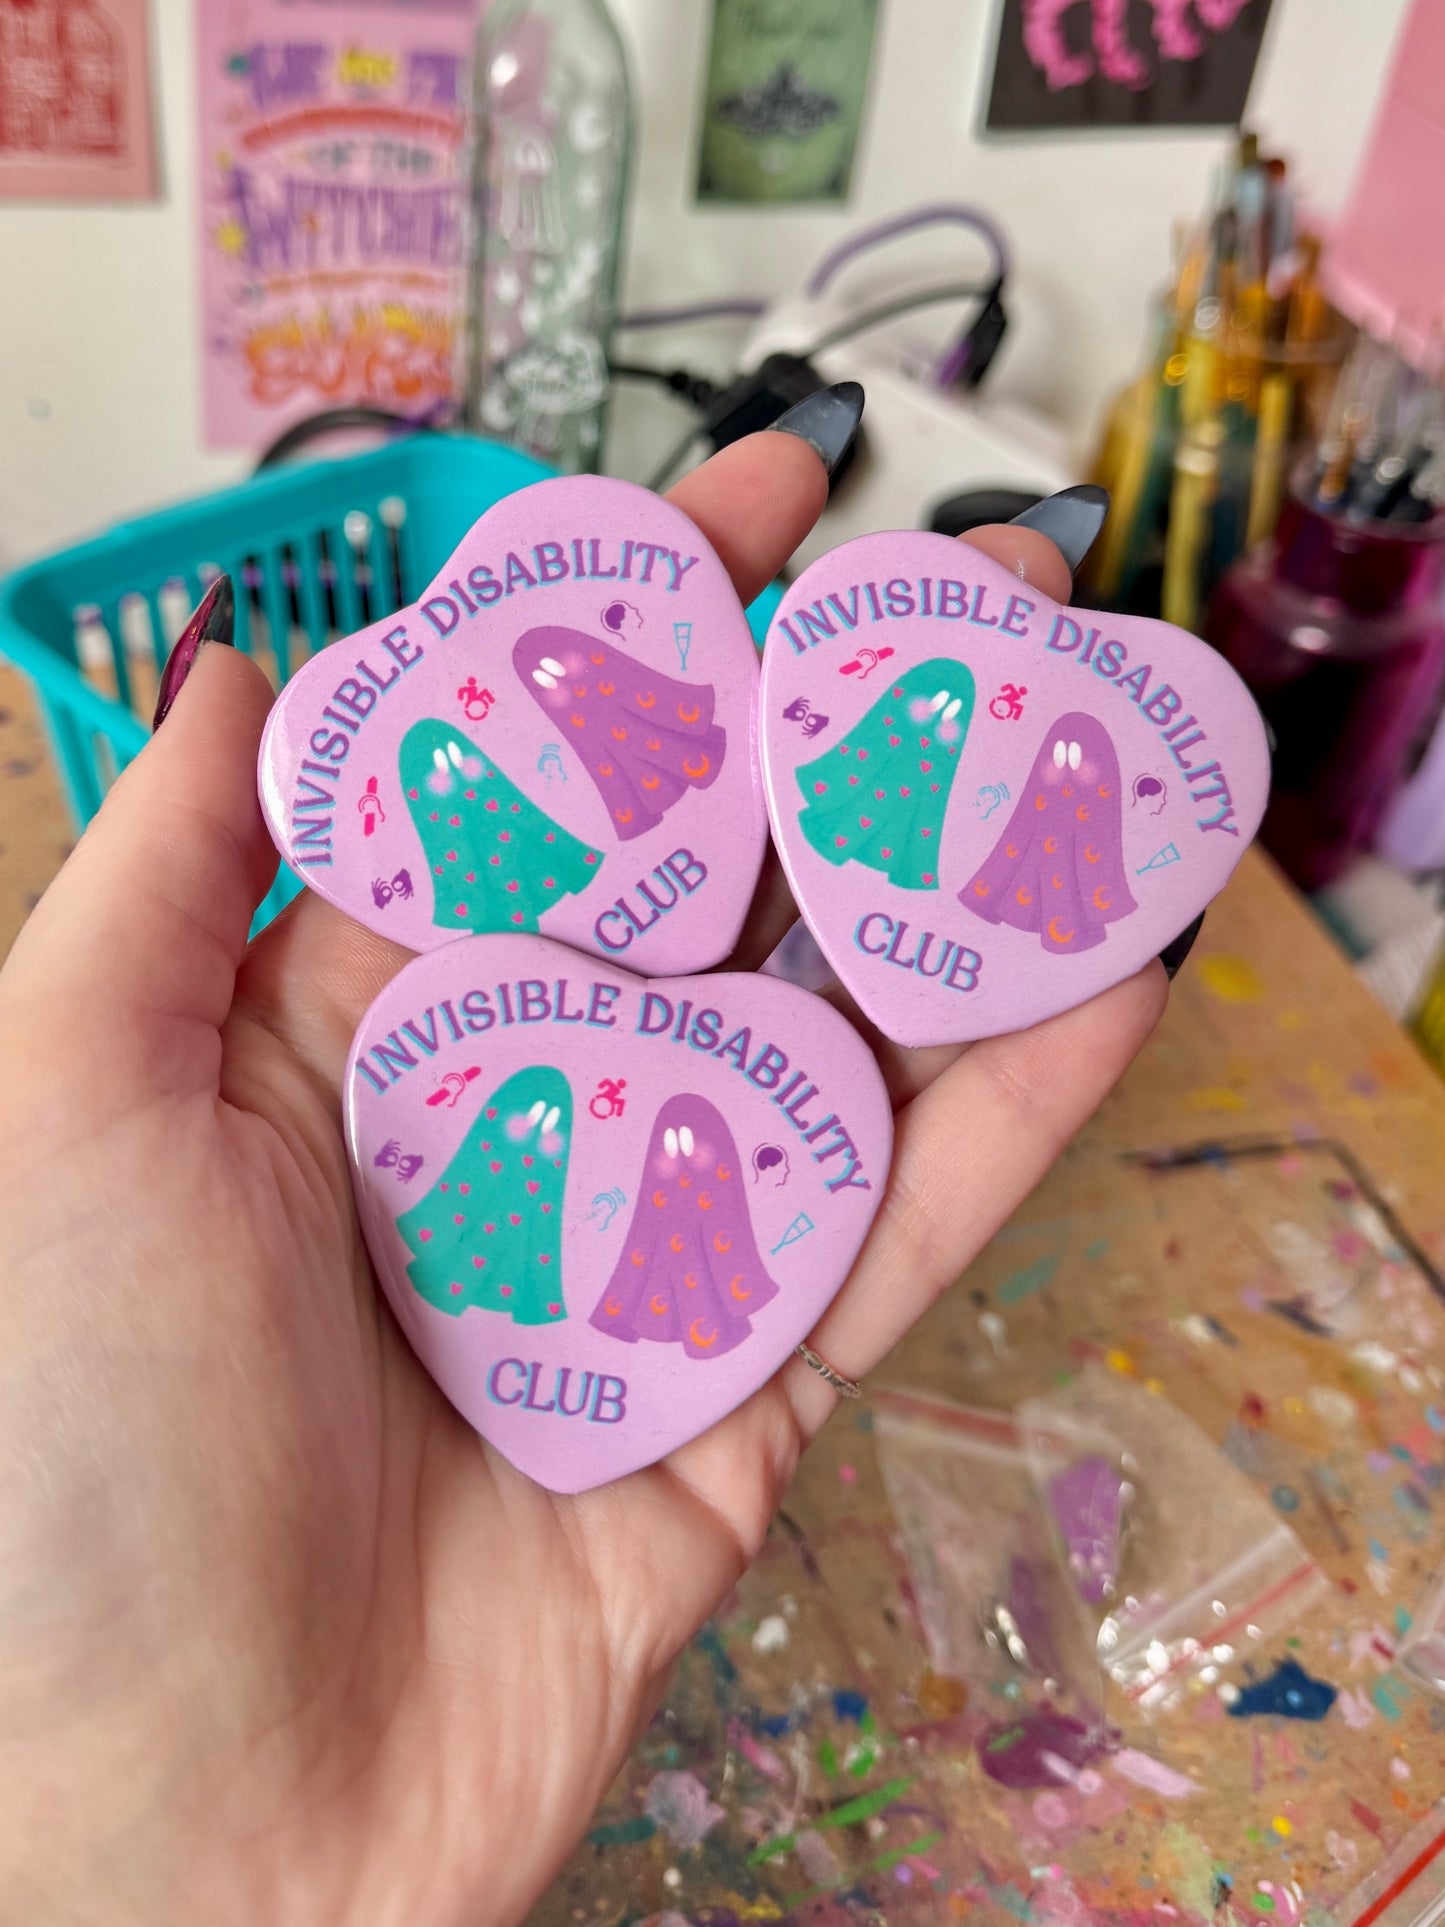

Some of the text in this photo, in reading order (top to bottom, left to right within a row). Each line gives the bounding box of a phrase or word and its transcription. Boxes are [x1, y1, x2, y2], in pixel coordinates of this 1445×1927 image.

[293, 538, 700, 867] INVISIBLE DISABILITY
[777, 578, 1239, 838] INVISIBLE DISABILITY
[593, 848, 709, 954] CLUB
[853, 912, 984, 994] CLUB
[355, 979, 871, 1196] INVISIBLE DISABILITY
[485, 1358, 628, 1425] CLUB
